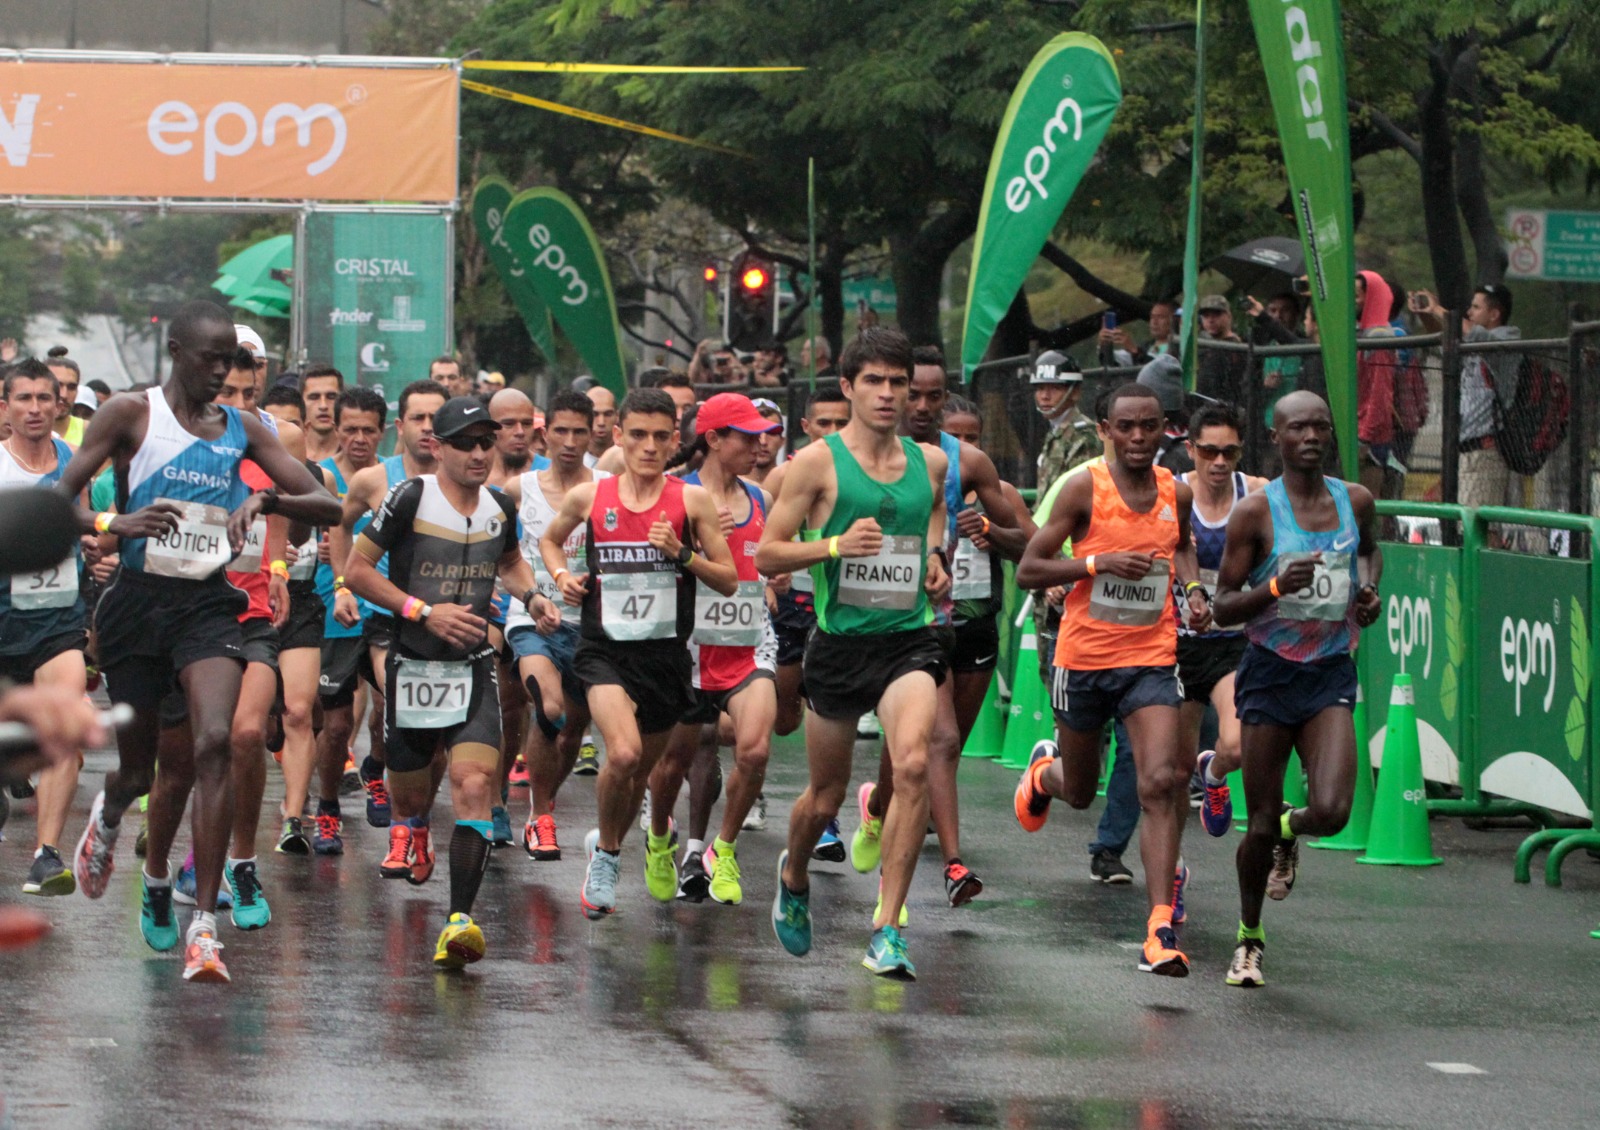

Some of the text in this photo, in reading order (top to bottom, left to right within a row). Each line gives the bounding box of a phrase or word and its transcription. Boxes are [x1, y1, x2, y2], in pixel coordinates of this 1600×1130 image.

[147, 100, 347, 182] epm
[1005, 97, 1083, 213] epm
[335, 258, 415, 277] CRISTAL
[528, 223, 588, 306] epm
[1036, 364, 1056, 379] PM
[162, 465, 231, 489] GARMIN
[156, 530, 219, 554] ROTICH
[653, 562, 676, 572] TEAM
[844, 563, 913, 583] FRANCO
[655, 574, 670, 585] 42K
[1103, 581, 1156, 603] MUINDI
[621, 594, 656, 620] 47
[704, 601, 753, 626] 490
[1387, 594, 1433, 680] epm
[1501, 615, 1556, 717] epm
[402, 682, 466, 707] 1071
[1403, 789, 1425, 806] ep
